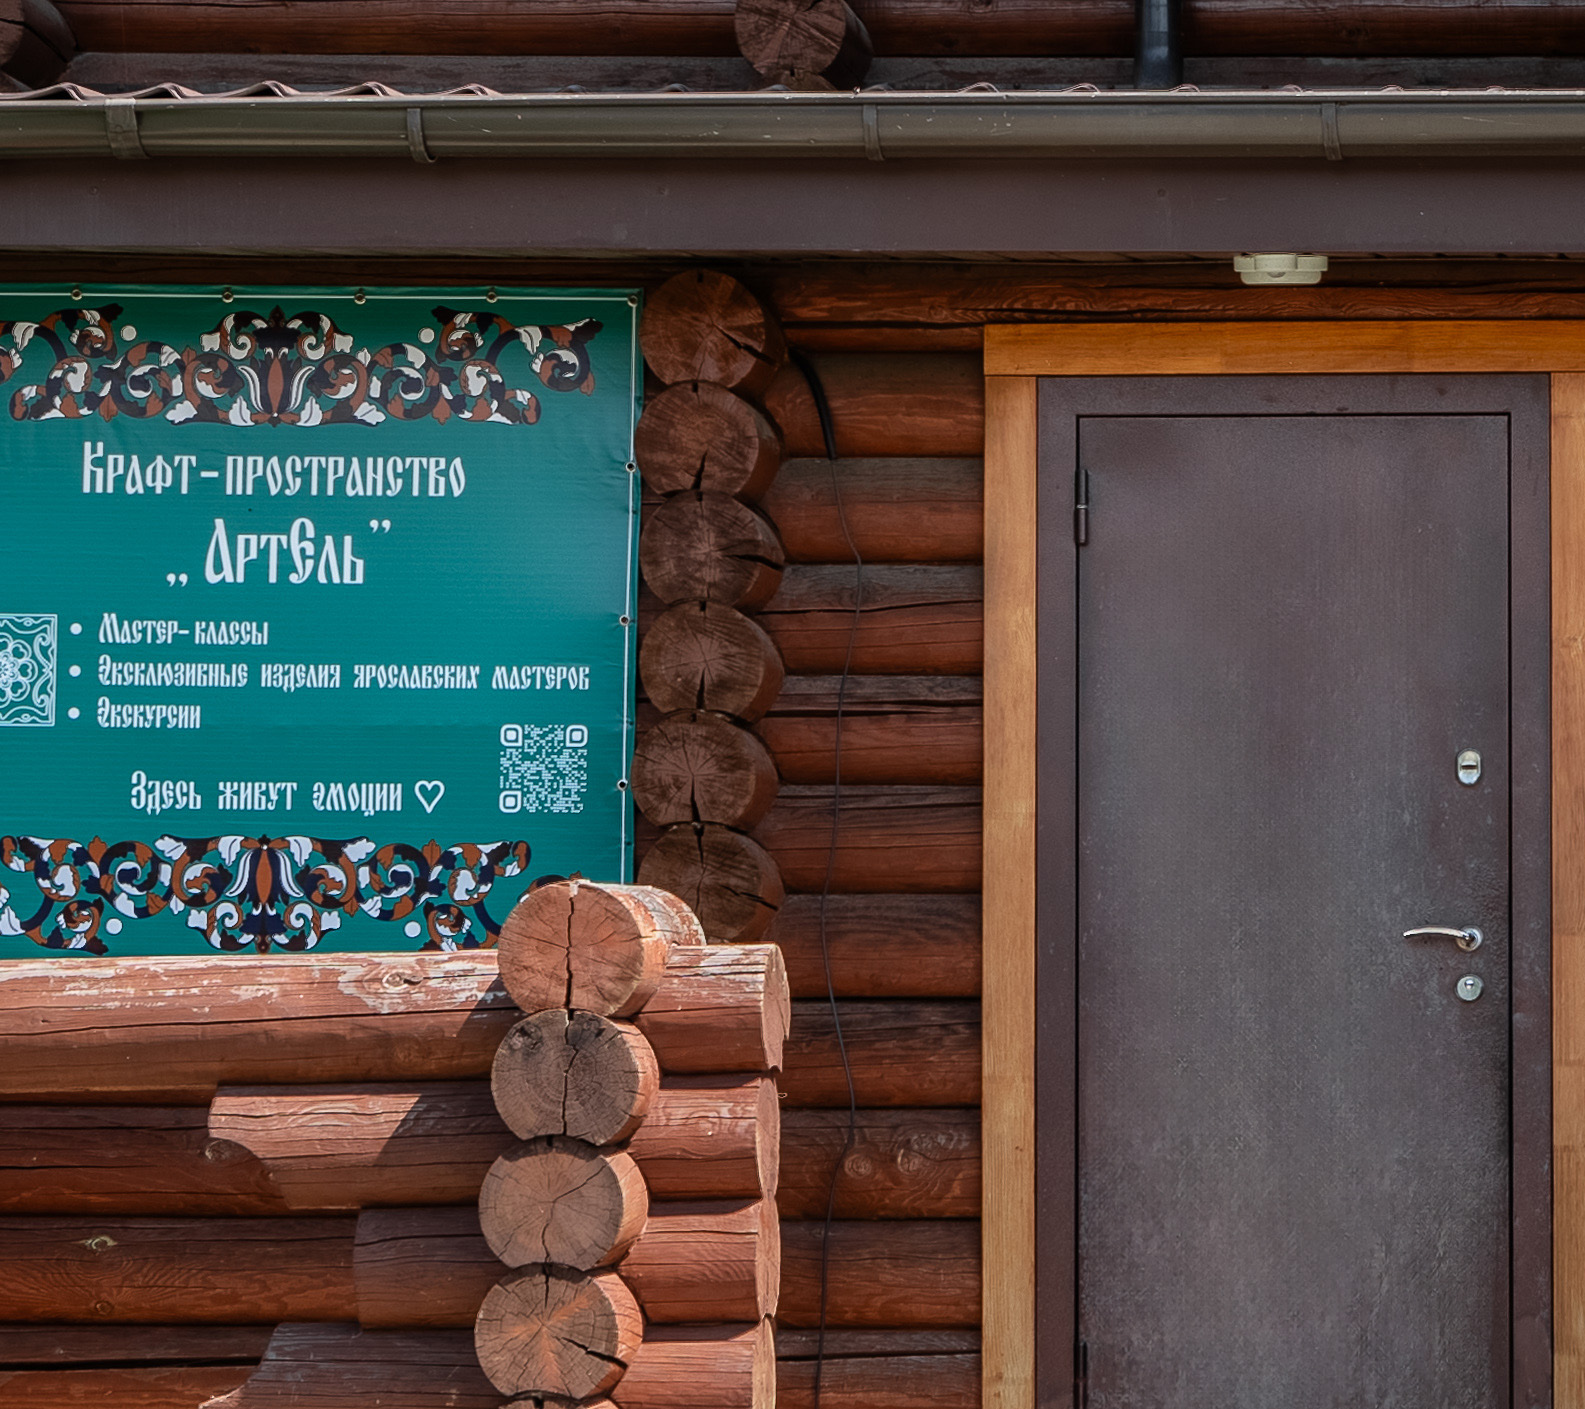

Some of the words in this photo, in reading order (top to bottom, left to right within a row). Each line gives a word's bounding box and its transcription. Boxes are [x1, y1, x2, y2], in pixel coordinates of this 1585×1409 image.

[81, 440, 467, 497] Крафт-пространство
[98, 653, 249, 688] Эксклюзивные
[260, 662, 341, 693] изделия
[353, 664, 480, 690] ярославских
[491, 665, 591, 691] мастеров
[97, 695, 202, 729] Экскурсии
[130, 770, 203, 816] Здесь
[217, 780, 298, 812] живут
[312, 780, 403, 817] эмоции
